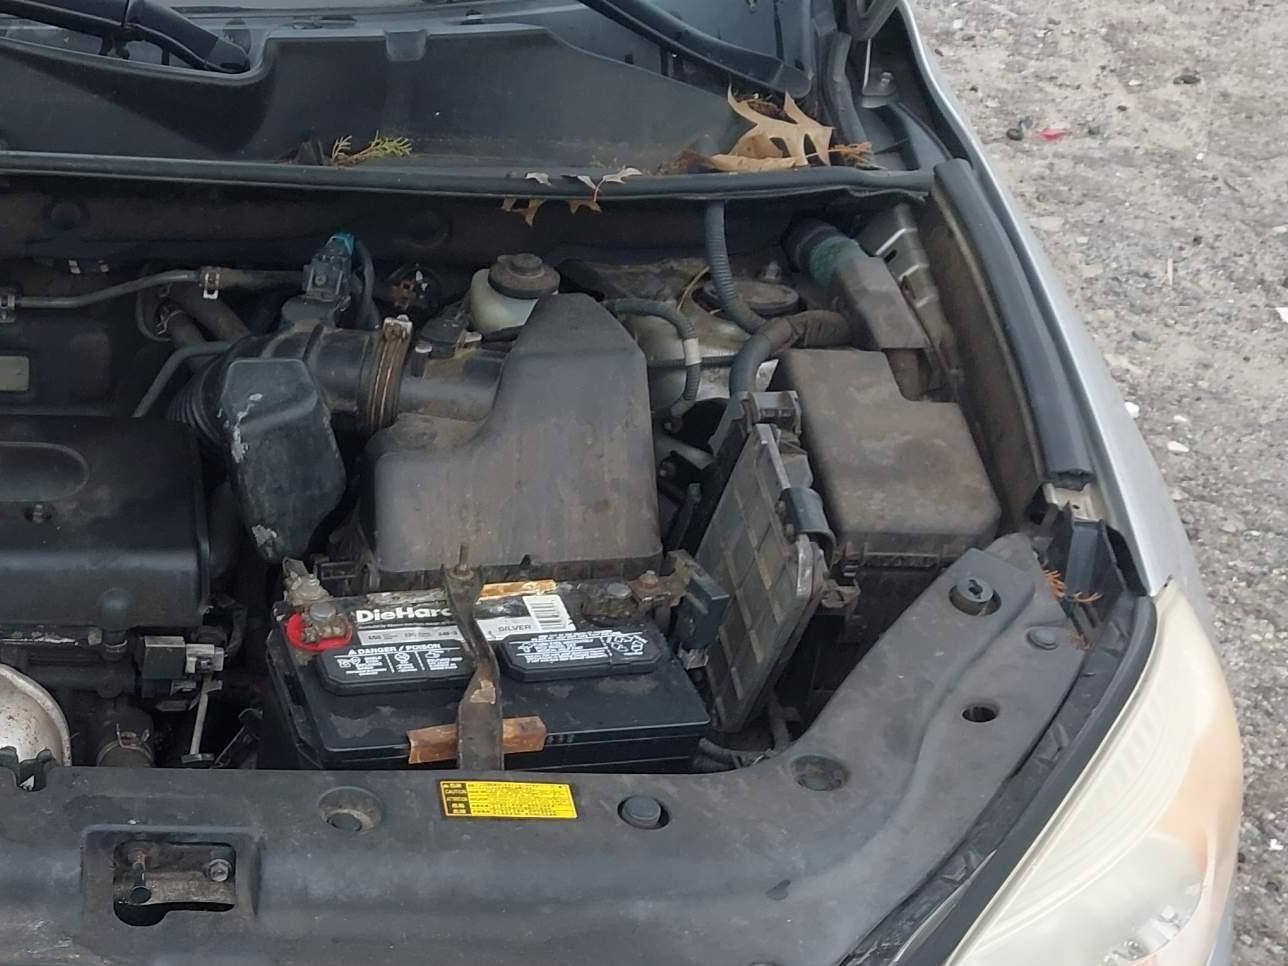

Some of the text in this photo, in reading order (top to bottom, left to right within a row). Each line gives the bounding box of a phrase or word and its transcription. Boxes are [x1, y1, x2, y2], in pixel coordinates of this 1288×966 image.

[498, 624, 532, 633] SILVER
[358, 646, 397, 655] DANGER
[405, 643, 441, 651] POISON
